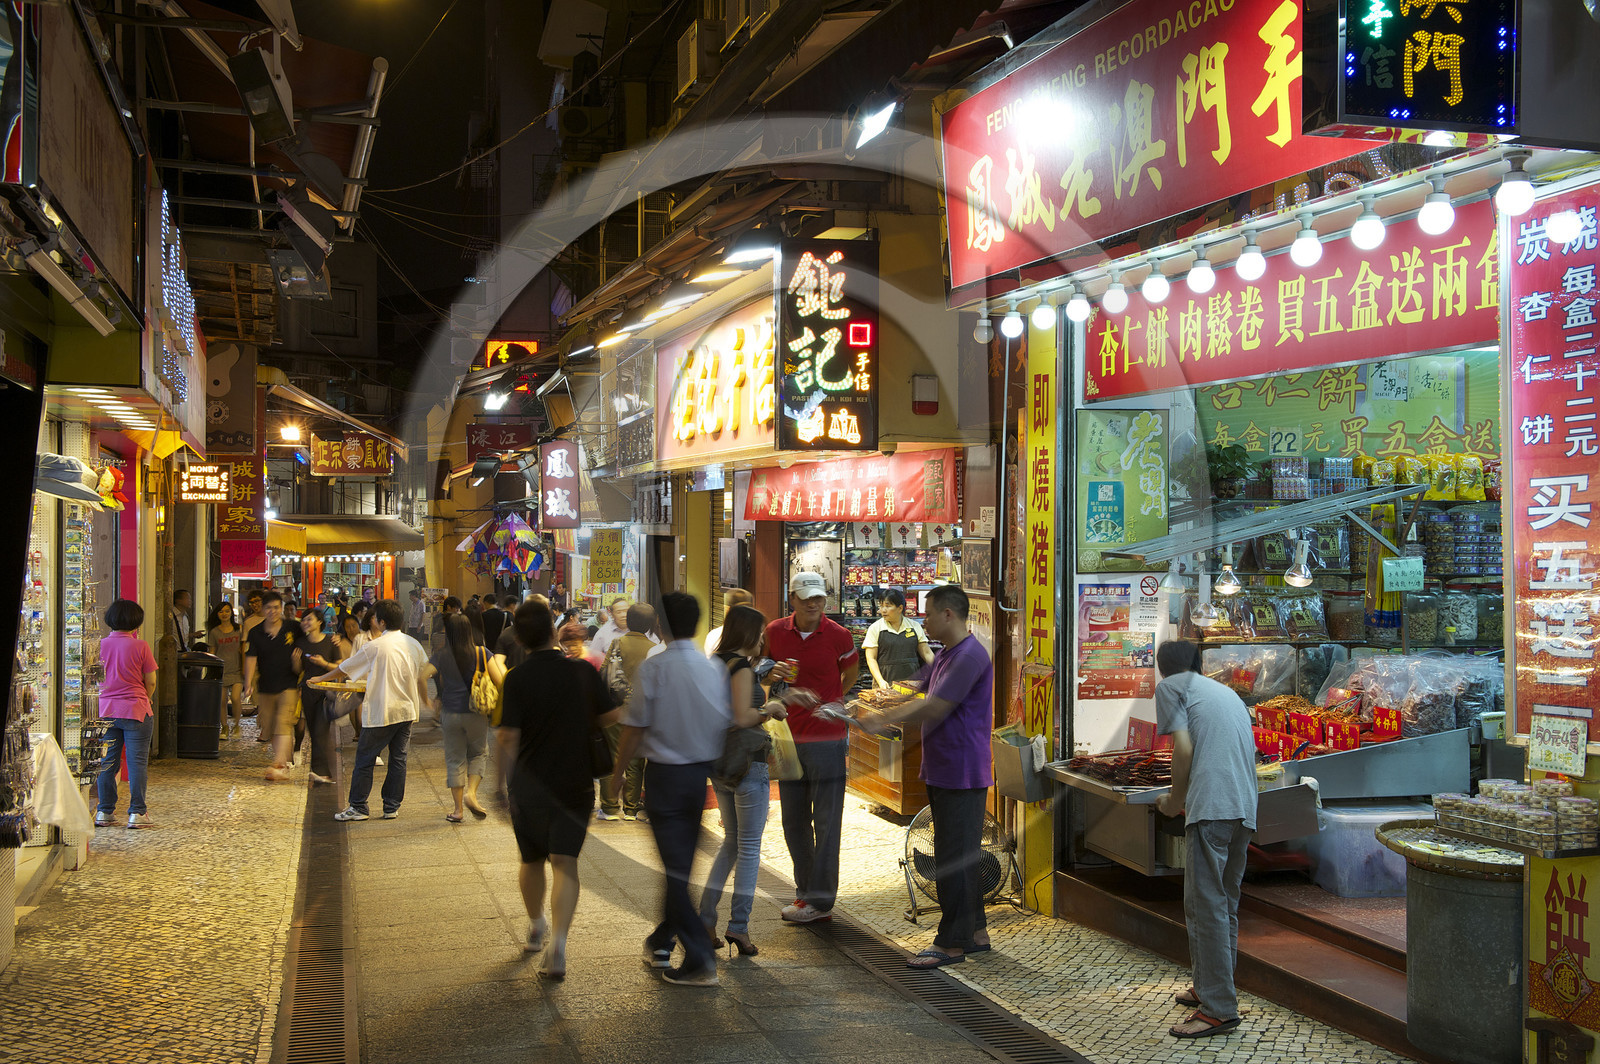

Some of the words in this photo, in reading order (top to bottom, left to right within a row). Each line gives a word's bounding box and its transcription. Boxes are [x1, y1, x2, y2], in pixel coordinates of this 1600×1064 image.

[986, 97, 1025, 137] FENG
[1099, 305, 1170, 378] 杏仁餅
[1179, 285, 1265, 362] 肉鬆卷
[1275, 229, 1499, 347] 買五盒送兩盒
[854, 352, 871, 391] 手信
[1518, 290, 1554, 446] 杏仁饼
[1561, 263, 1600, 458] 每盒二十二元
[189, 465, 219, 473] MONEY
[316, 440, 343, 470] 正宗
[346, 437, 361, 470] 餅家
[1121, 411, 1165, 519] 老澳門
[181, 492, 227, 501] EXCHANGE
[189, 475, 221, 490] 両替
[545, 448, 578, 520] 鳳城
[219, 523, 262, 534] 第二分店
[1527, 474, 1595, 719] 买五送二
